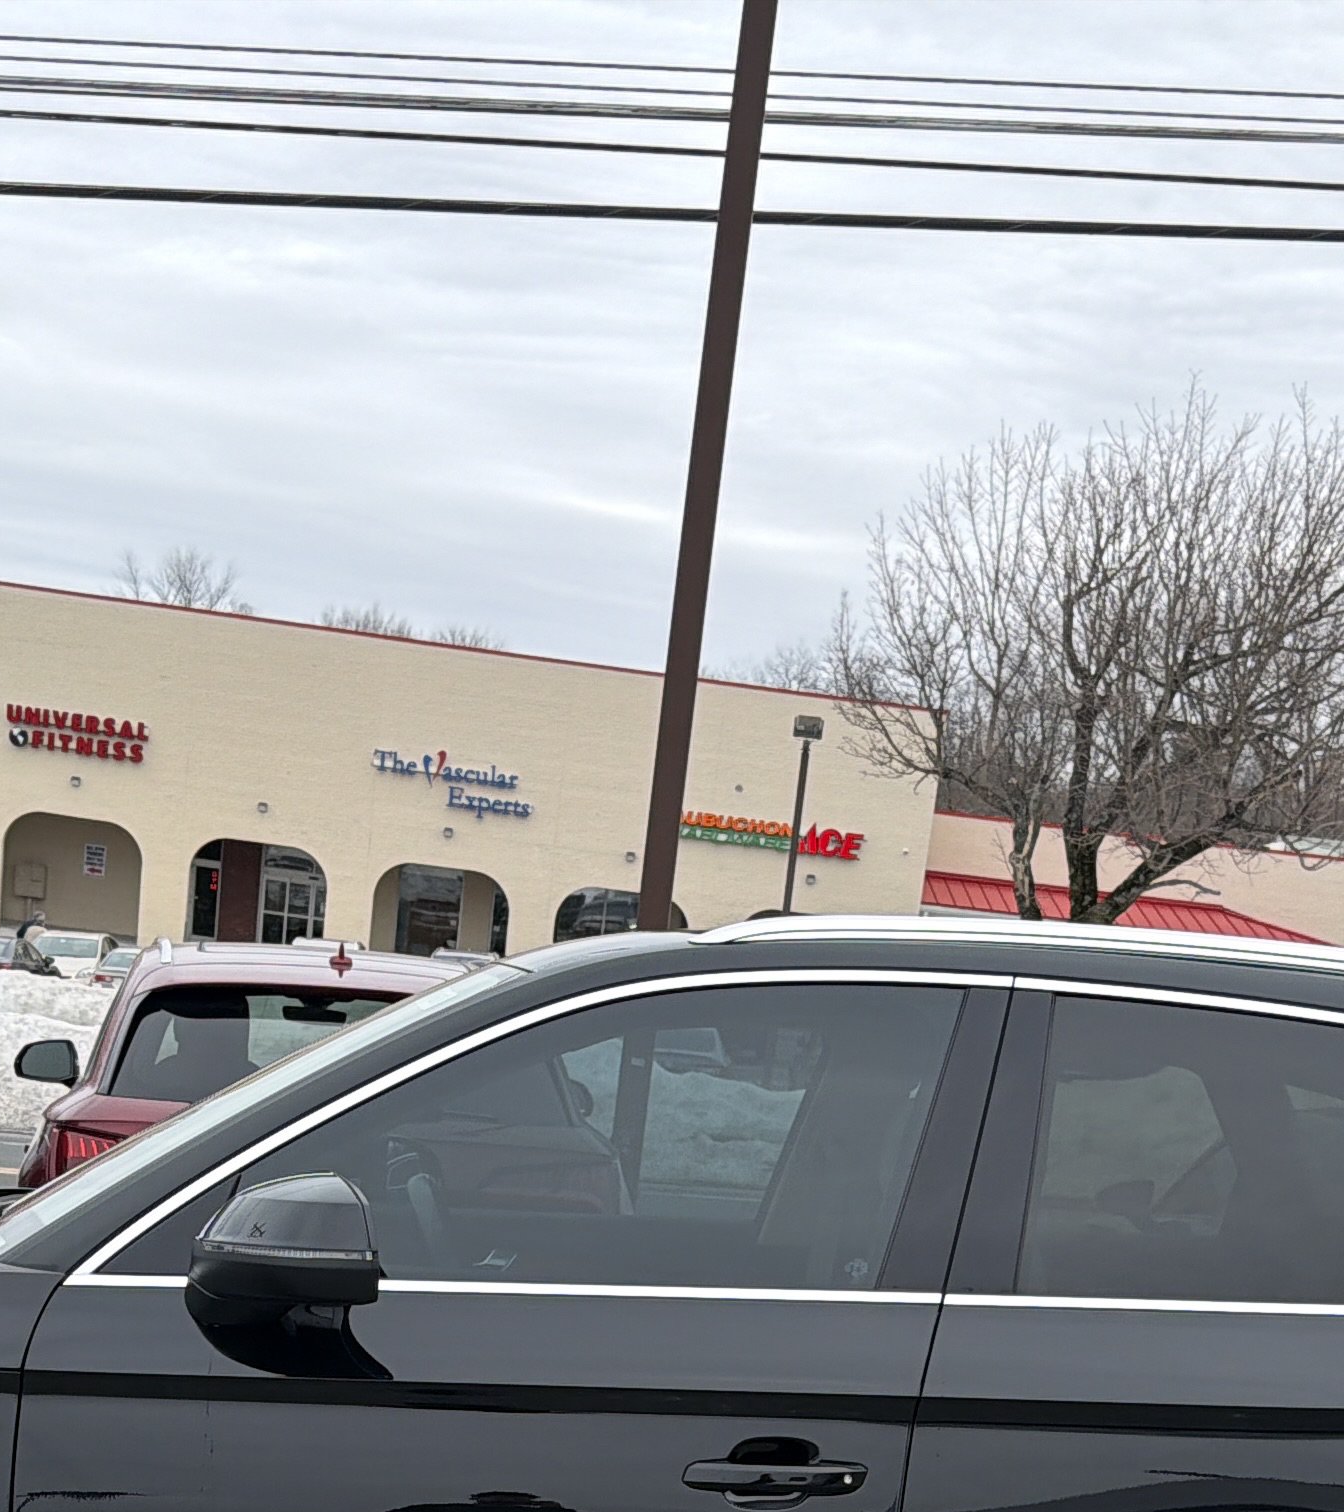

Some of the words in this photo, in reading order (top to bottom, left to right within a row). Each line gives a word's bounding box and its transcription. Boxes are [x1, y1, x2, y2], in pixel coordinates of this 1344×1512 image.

[6, 703, 149, 742] UNIVERSAL
[32, 730, 144, 763] FITNESS
[372, 749, 418, 775] The
[423, 750, 519, 789] Vascular
[446, 786, 534, 818] Experts
[680, 825, 792, 853] ARDWARE
[797, 822, 867, 862] ACE
